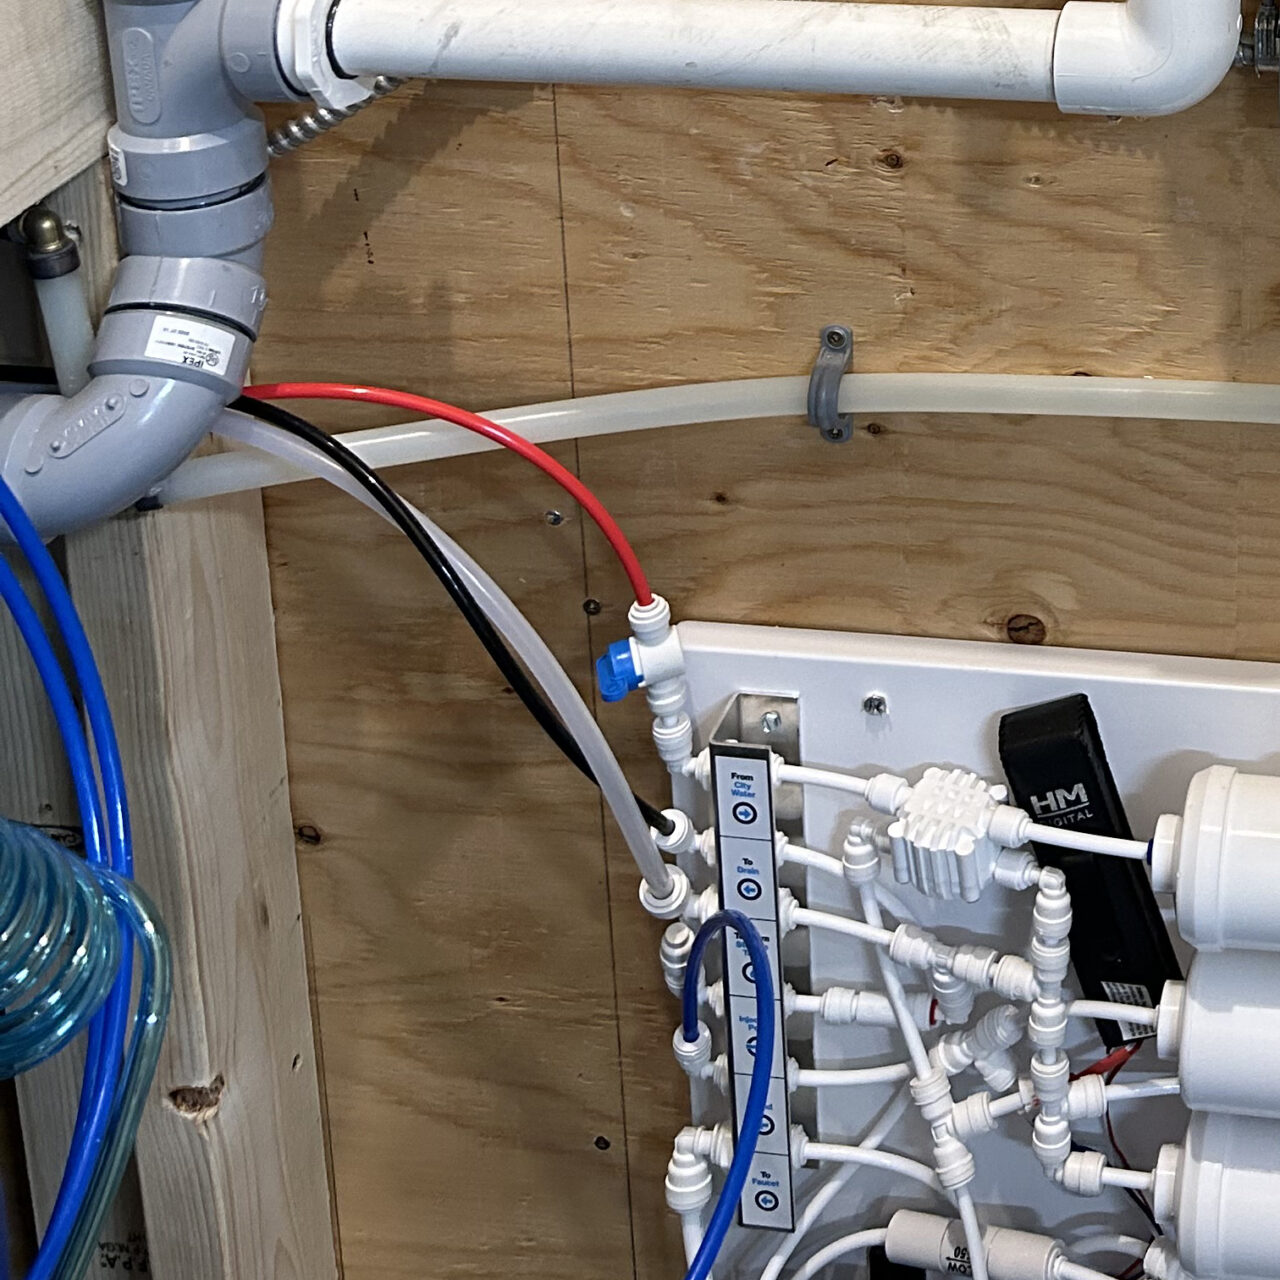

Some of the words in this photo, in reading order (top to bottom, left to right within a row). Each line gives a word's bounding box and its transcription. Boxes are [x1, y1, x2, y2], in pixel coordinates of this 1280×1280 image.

[731, 772, 754, 781] From
[734, 781, 751, 790] City
[731, 789, 756, 798] Water
[1030, 783, 1088, 814] HM
[742, 858, 754, 866] To
[736, 865, 760, 875] Drain
[760, 1171, 771, 1179] To
[752, 1178, 779, 1187] Faucet
